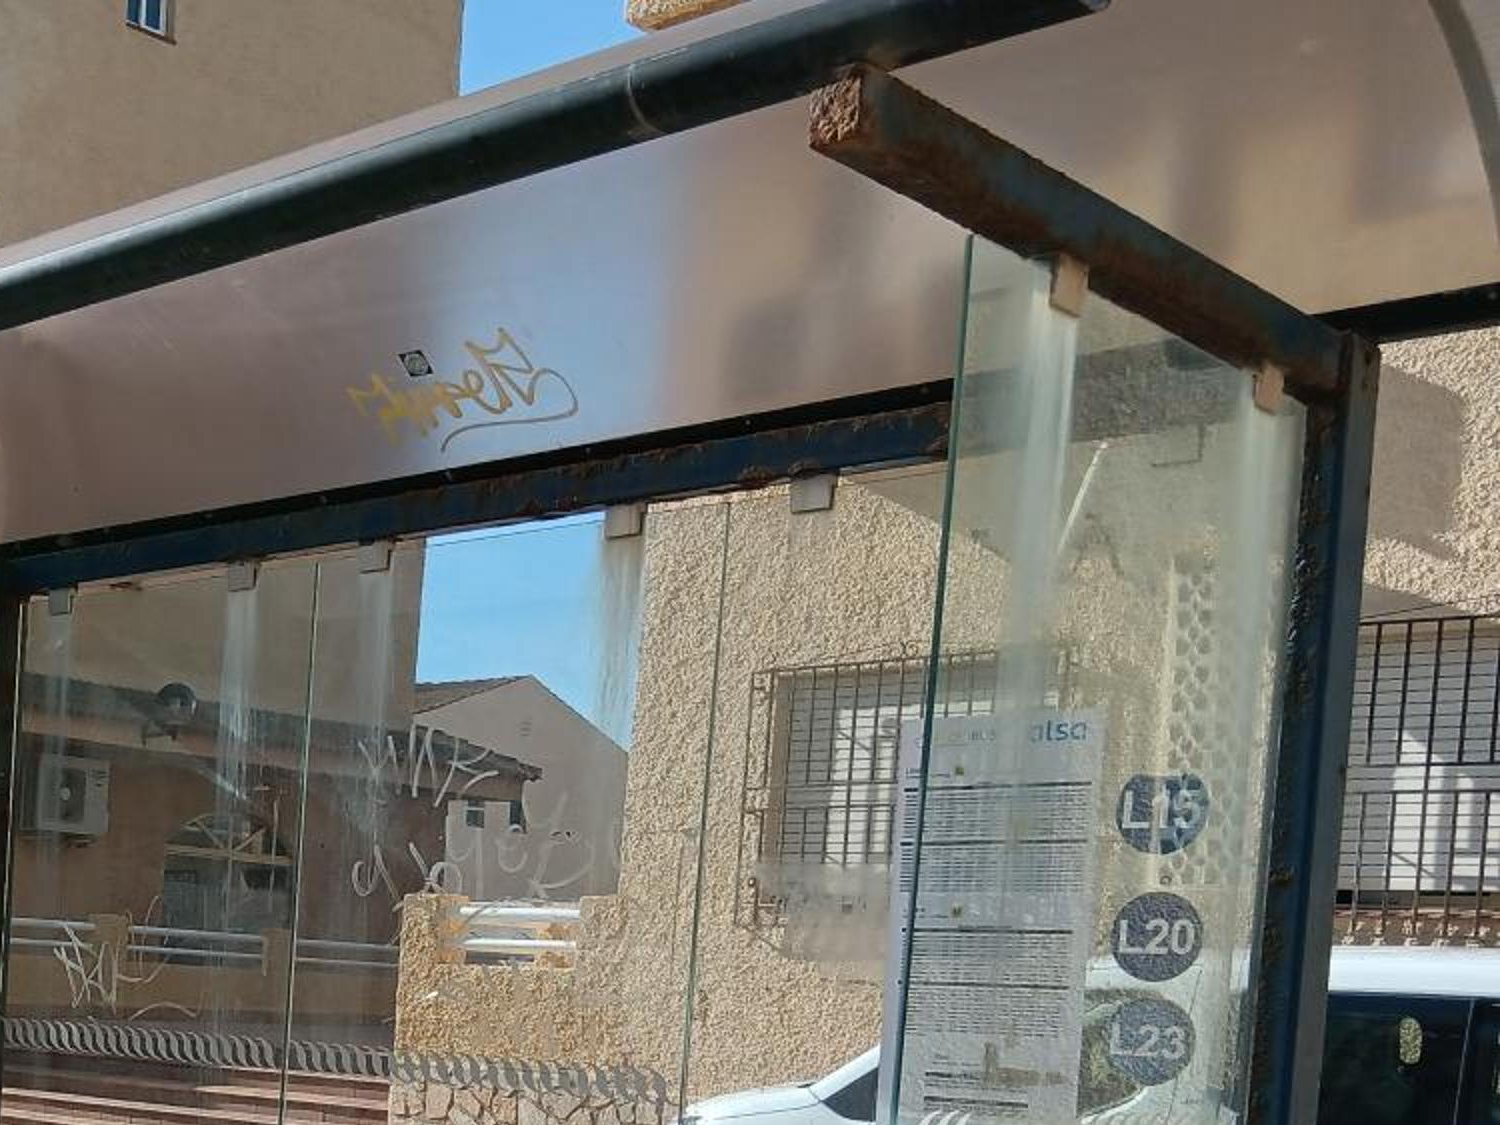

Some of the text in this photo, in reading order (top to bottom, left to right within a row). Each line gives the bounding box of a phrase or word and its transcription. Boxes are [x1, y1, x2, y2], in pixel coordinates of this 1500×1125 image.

[1030, 720, 1088, 742] alsa
[1119, 919, 1196, 955] L20
[1110, 1023, 1186, 1058] L23
